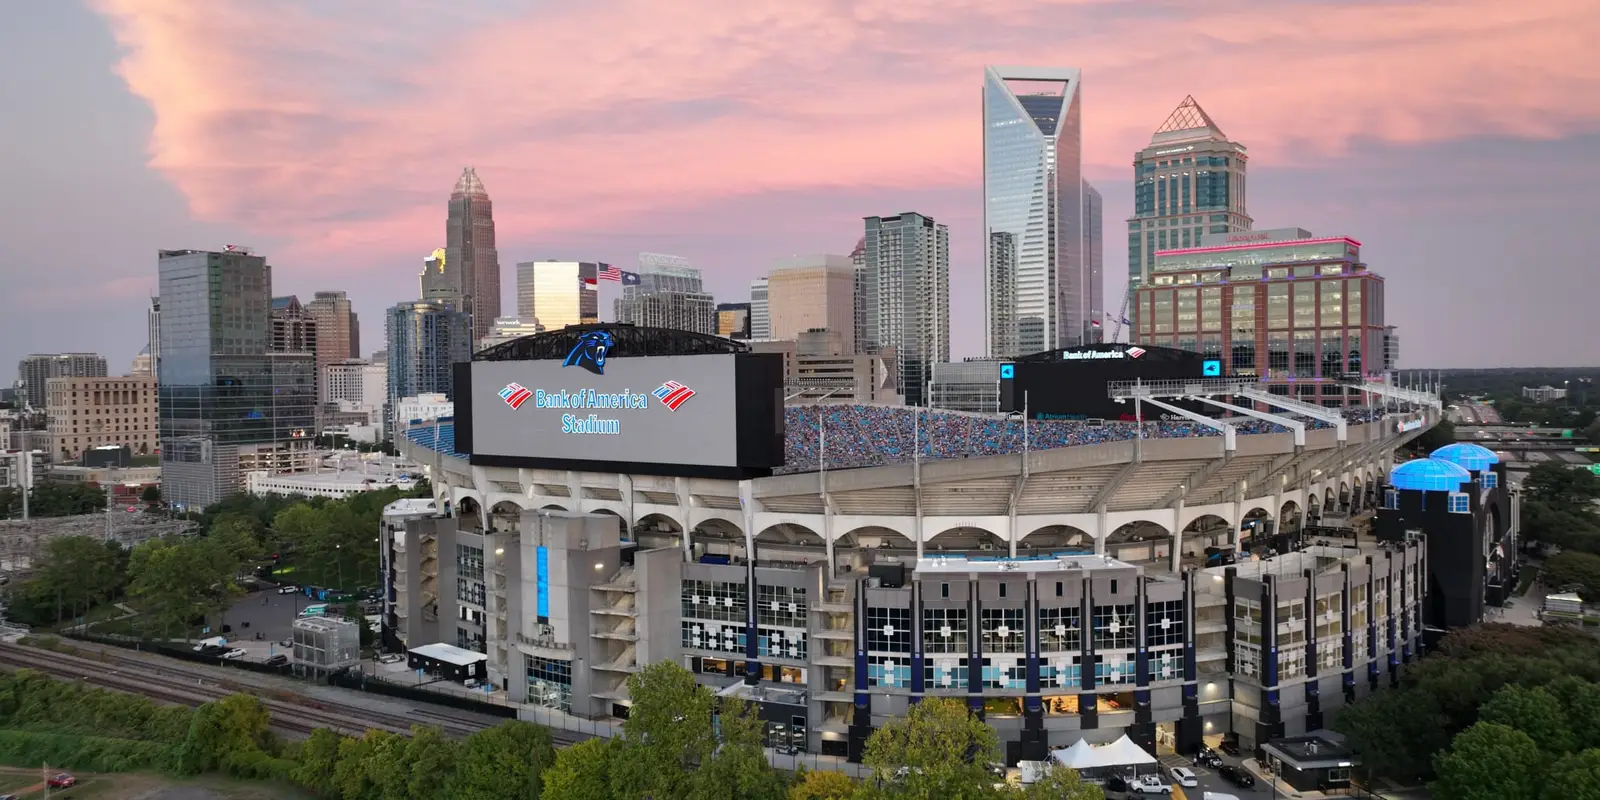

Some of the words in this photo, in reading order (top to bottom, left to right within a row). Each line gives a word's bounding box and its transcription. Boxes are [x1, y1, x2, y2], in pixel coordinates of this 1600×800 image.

[1063, 350, 1082, 360] Bank
[1083, 349, 1091, 359] of
[1091, 349, 1124, 359] America
[536, 389, 571, 409] Bank
[571, 388, 586, 409] of
[587, 388, 648, 409] America
[561, 413, 620, 434] Stadium
